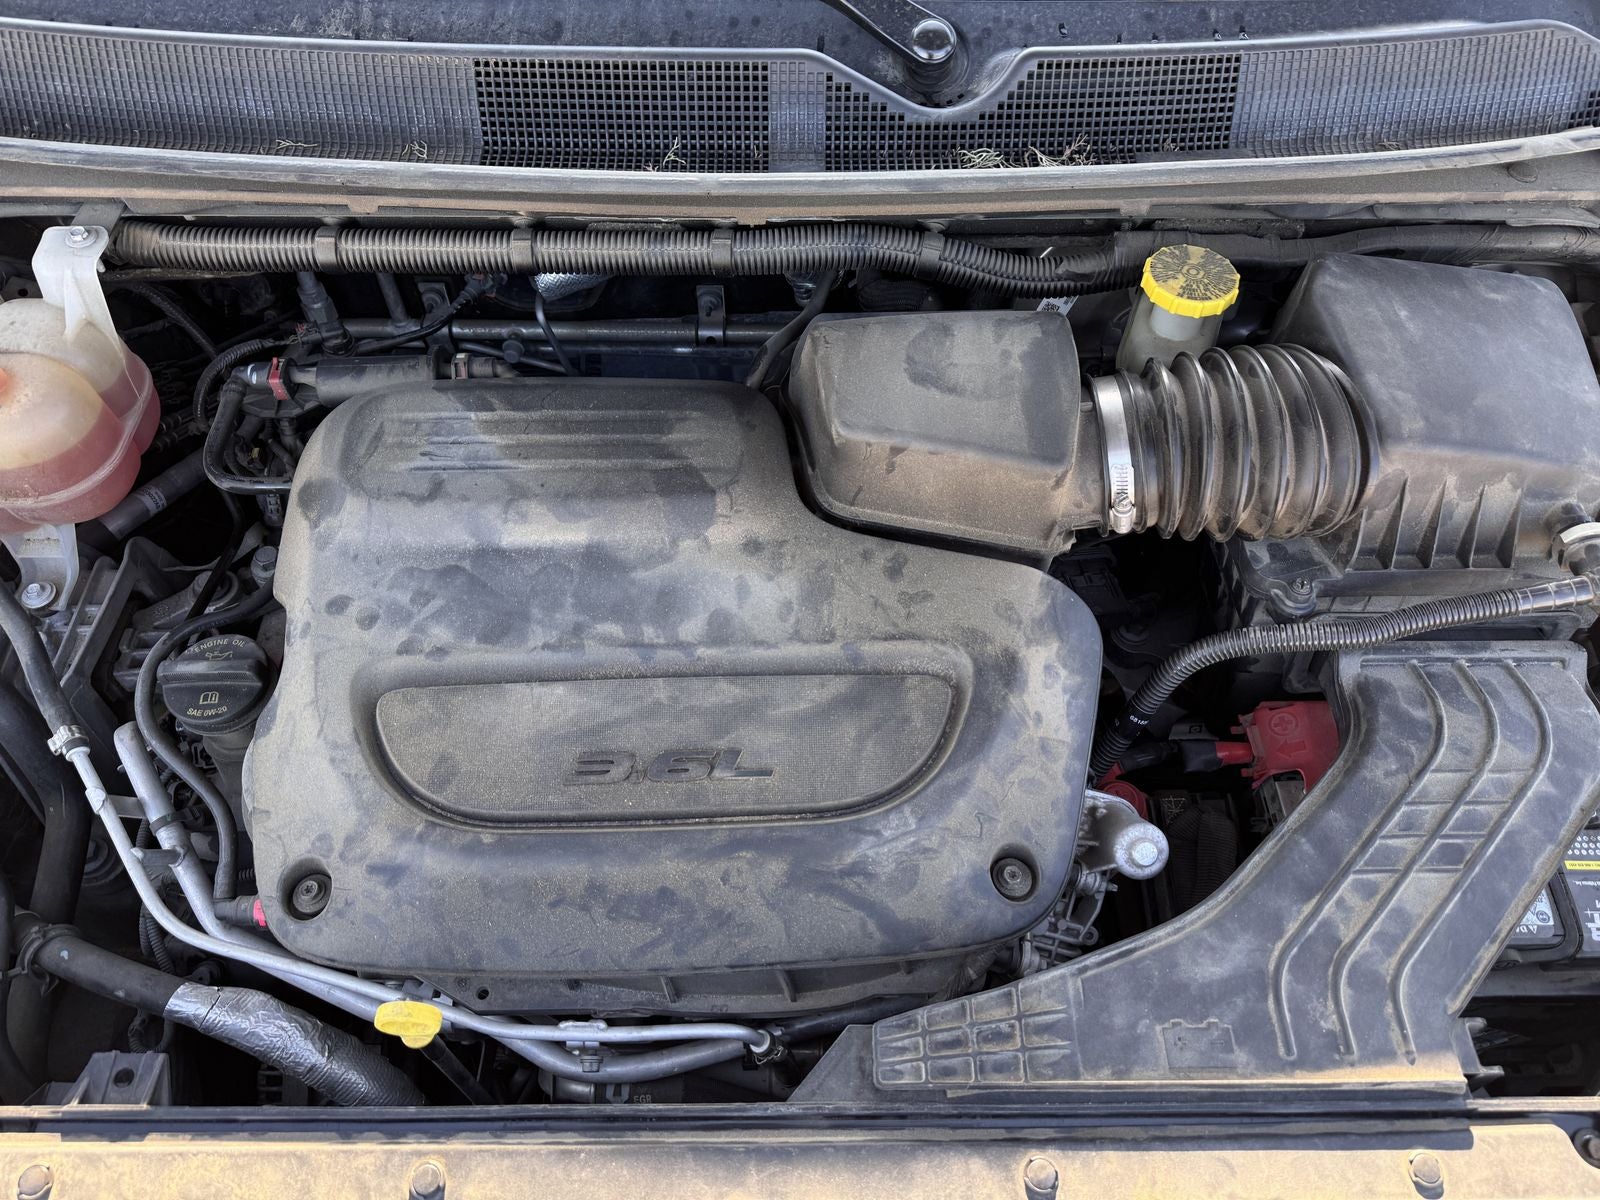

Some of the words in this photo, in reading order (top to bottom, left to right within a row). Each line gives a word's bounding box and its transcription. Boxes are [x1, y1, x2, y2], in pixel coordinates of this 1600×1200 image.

[194, 639, 228, 653] ENGINE
[232, 639, 246, 648] OIL
[187, 707, 203, 717] SAE
[203, 706, 228, 717] 0W-20
[563, 747, 777, 786] 3.6L
